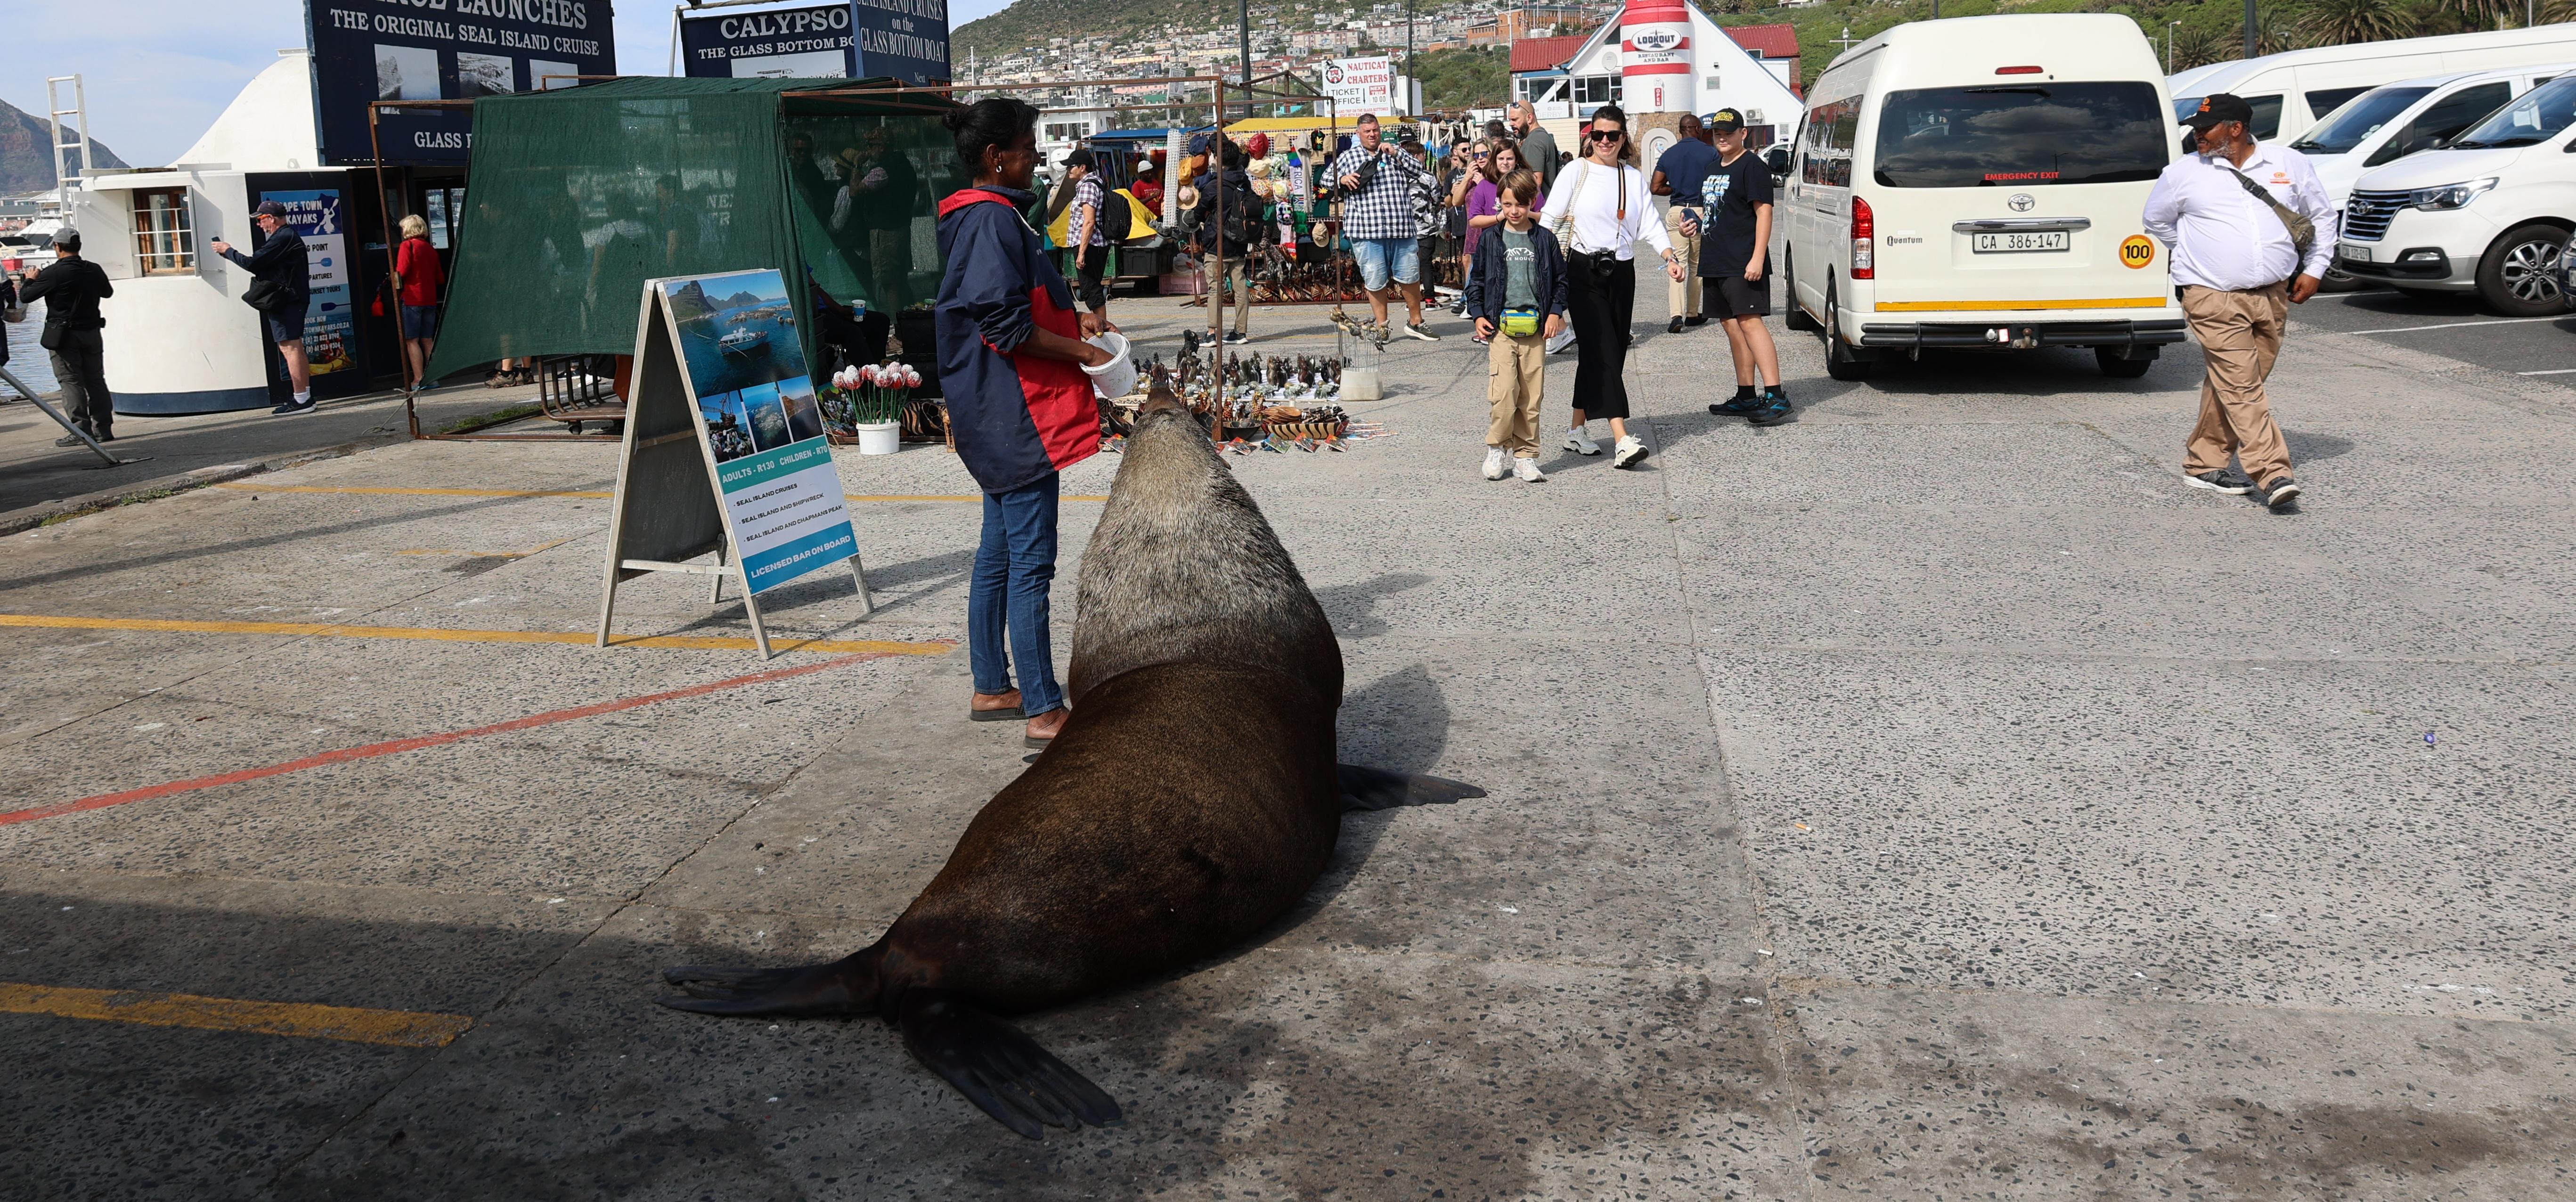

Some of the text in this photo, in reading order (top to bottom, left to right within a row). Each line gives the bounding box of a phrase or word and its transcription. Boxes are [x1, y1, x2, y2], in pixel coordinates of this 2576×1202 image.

[910, 0, 943, 21] CRUISES
[720, 8, 848, 39] CALYPSO
[892, 16, 914, 33] on the
[330, 8, 599, 56] THE ORIGINAL SEAL ISLAND CRUISE
[1638, 35, 1675, 44] LOOKOUT
[698, 47, 726, 59] THE
[730, 43, 773, 57] GLASS
[776, 37, 835, 53] BOTTOM
[860, 27, 945, 63] GLASS BOTTOM BOAT
[1347, 61, 1386, 71] NAUTICAT
[914, 72, 926, 84] Next
[1347, 74, 1388, 84] CHARTERS
[1331, 88, 1360, 96] TICKET
[1334, 97, 1361, 106] OFFICE
[415, 131, 462, 148] GLASS
[1985, 172, 2038, 180] EMERGENCY
[283, 200, 323, 212] APE TOWN
[285, 213, 318, 224] KAYAKS
[312, 243, 328, 252] POINT
[1887, 236, 1922, 246] Quantum
[1981, 234, 2062, 249] CA 386-147
[2125, 245, 2150, 259] 100
[723, 467, 752, 483] ADULTS
[757, 461, 775, 473] R130
[780, 450, 812, 466] CHILDREN
[816, 445, 828, 455] R70
[736, 483, 798, 507] SEAL ISLAND CRUISES
[742, 493, 824, 524] SEAL ISLAND AND SHIPWRECK
[746, 505, 842, 541] SEAL ISLAND AND CHAPMANS PEAK
[751, 535, 850, 578] LICENSED BAR ON BOARD
